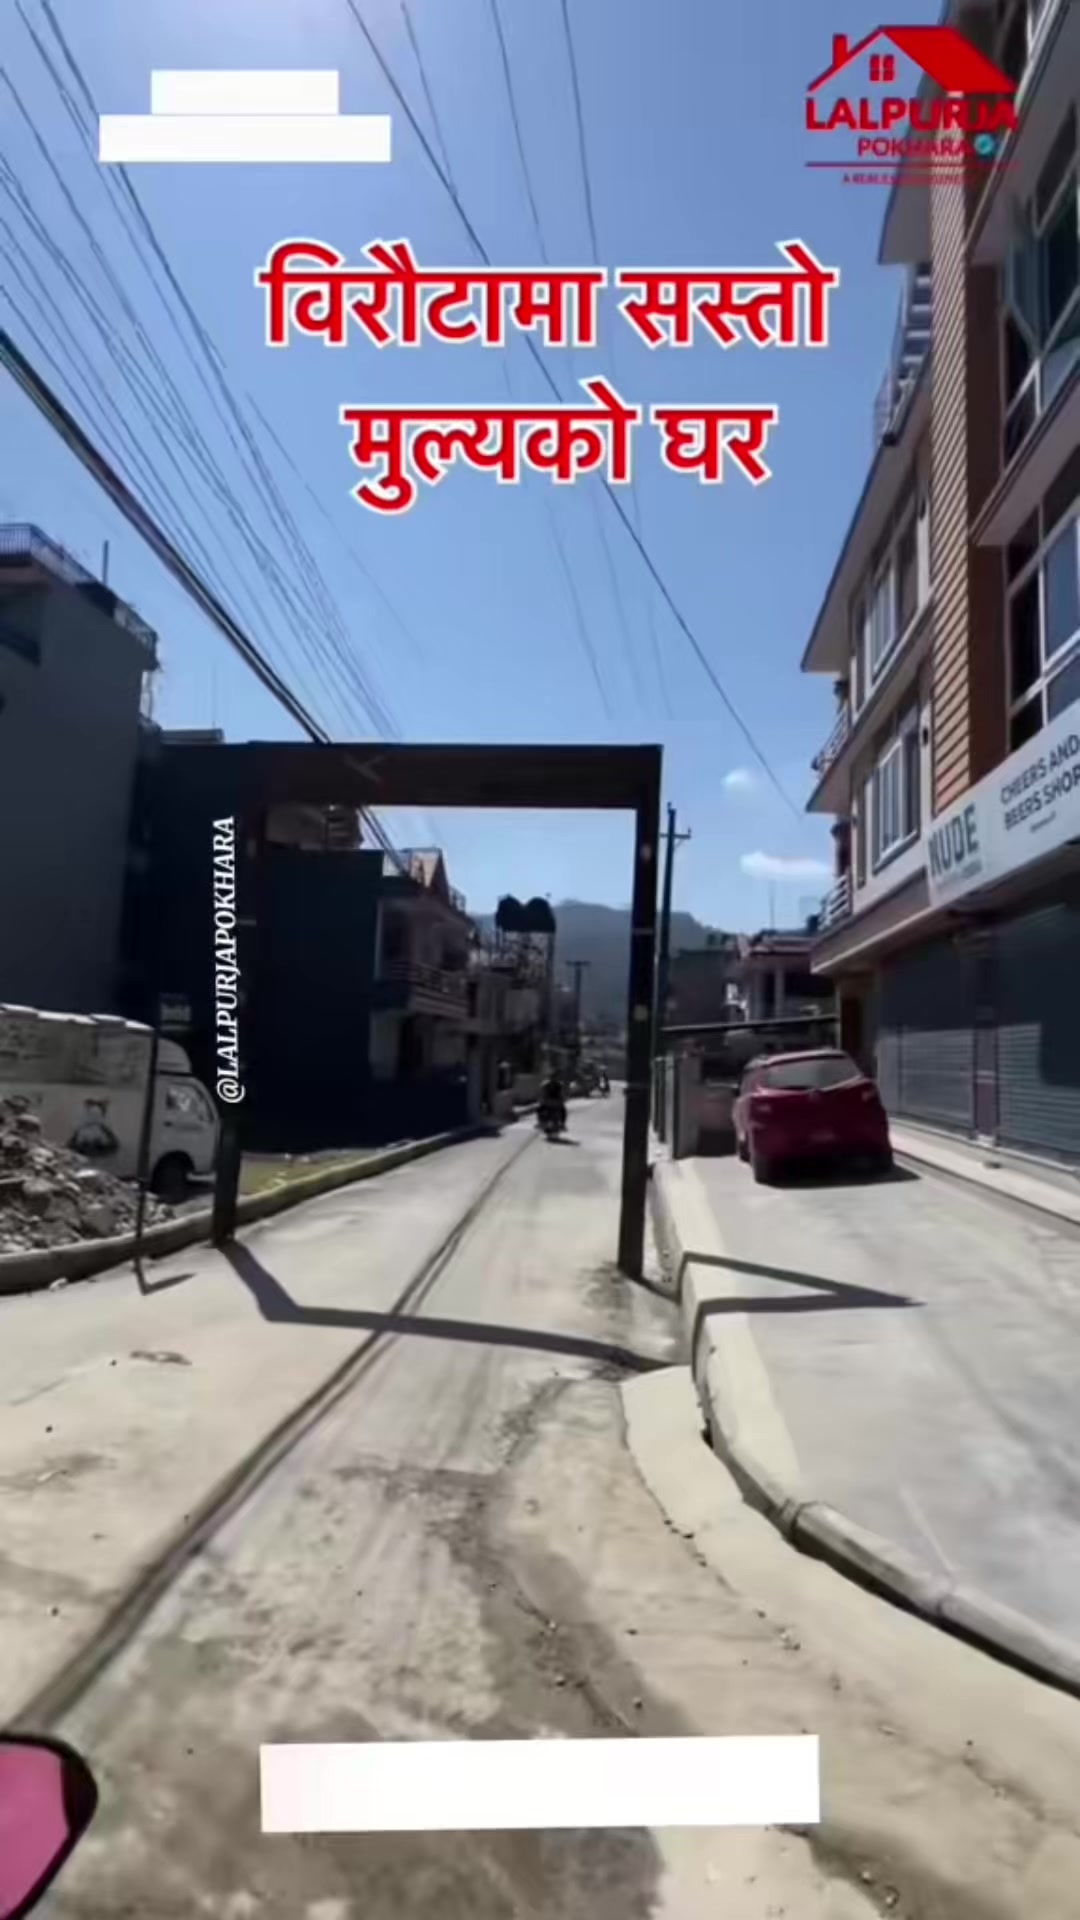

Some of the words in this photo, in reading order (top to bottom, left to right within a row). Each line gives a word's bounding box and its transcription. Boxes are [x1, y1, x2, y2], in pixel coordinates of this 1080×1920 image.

[1001, 757, 1047, 805] CHEERS
[1004, 791, 1043, 831] BEERS
[928, 802, 980, 878] NUDE
